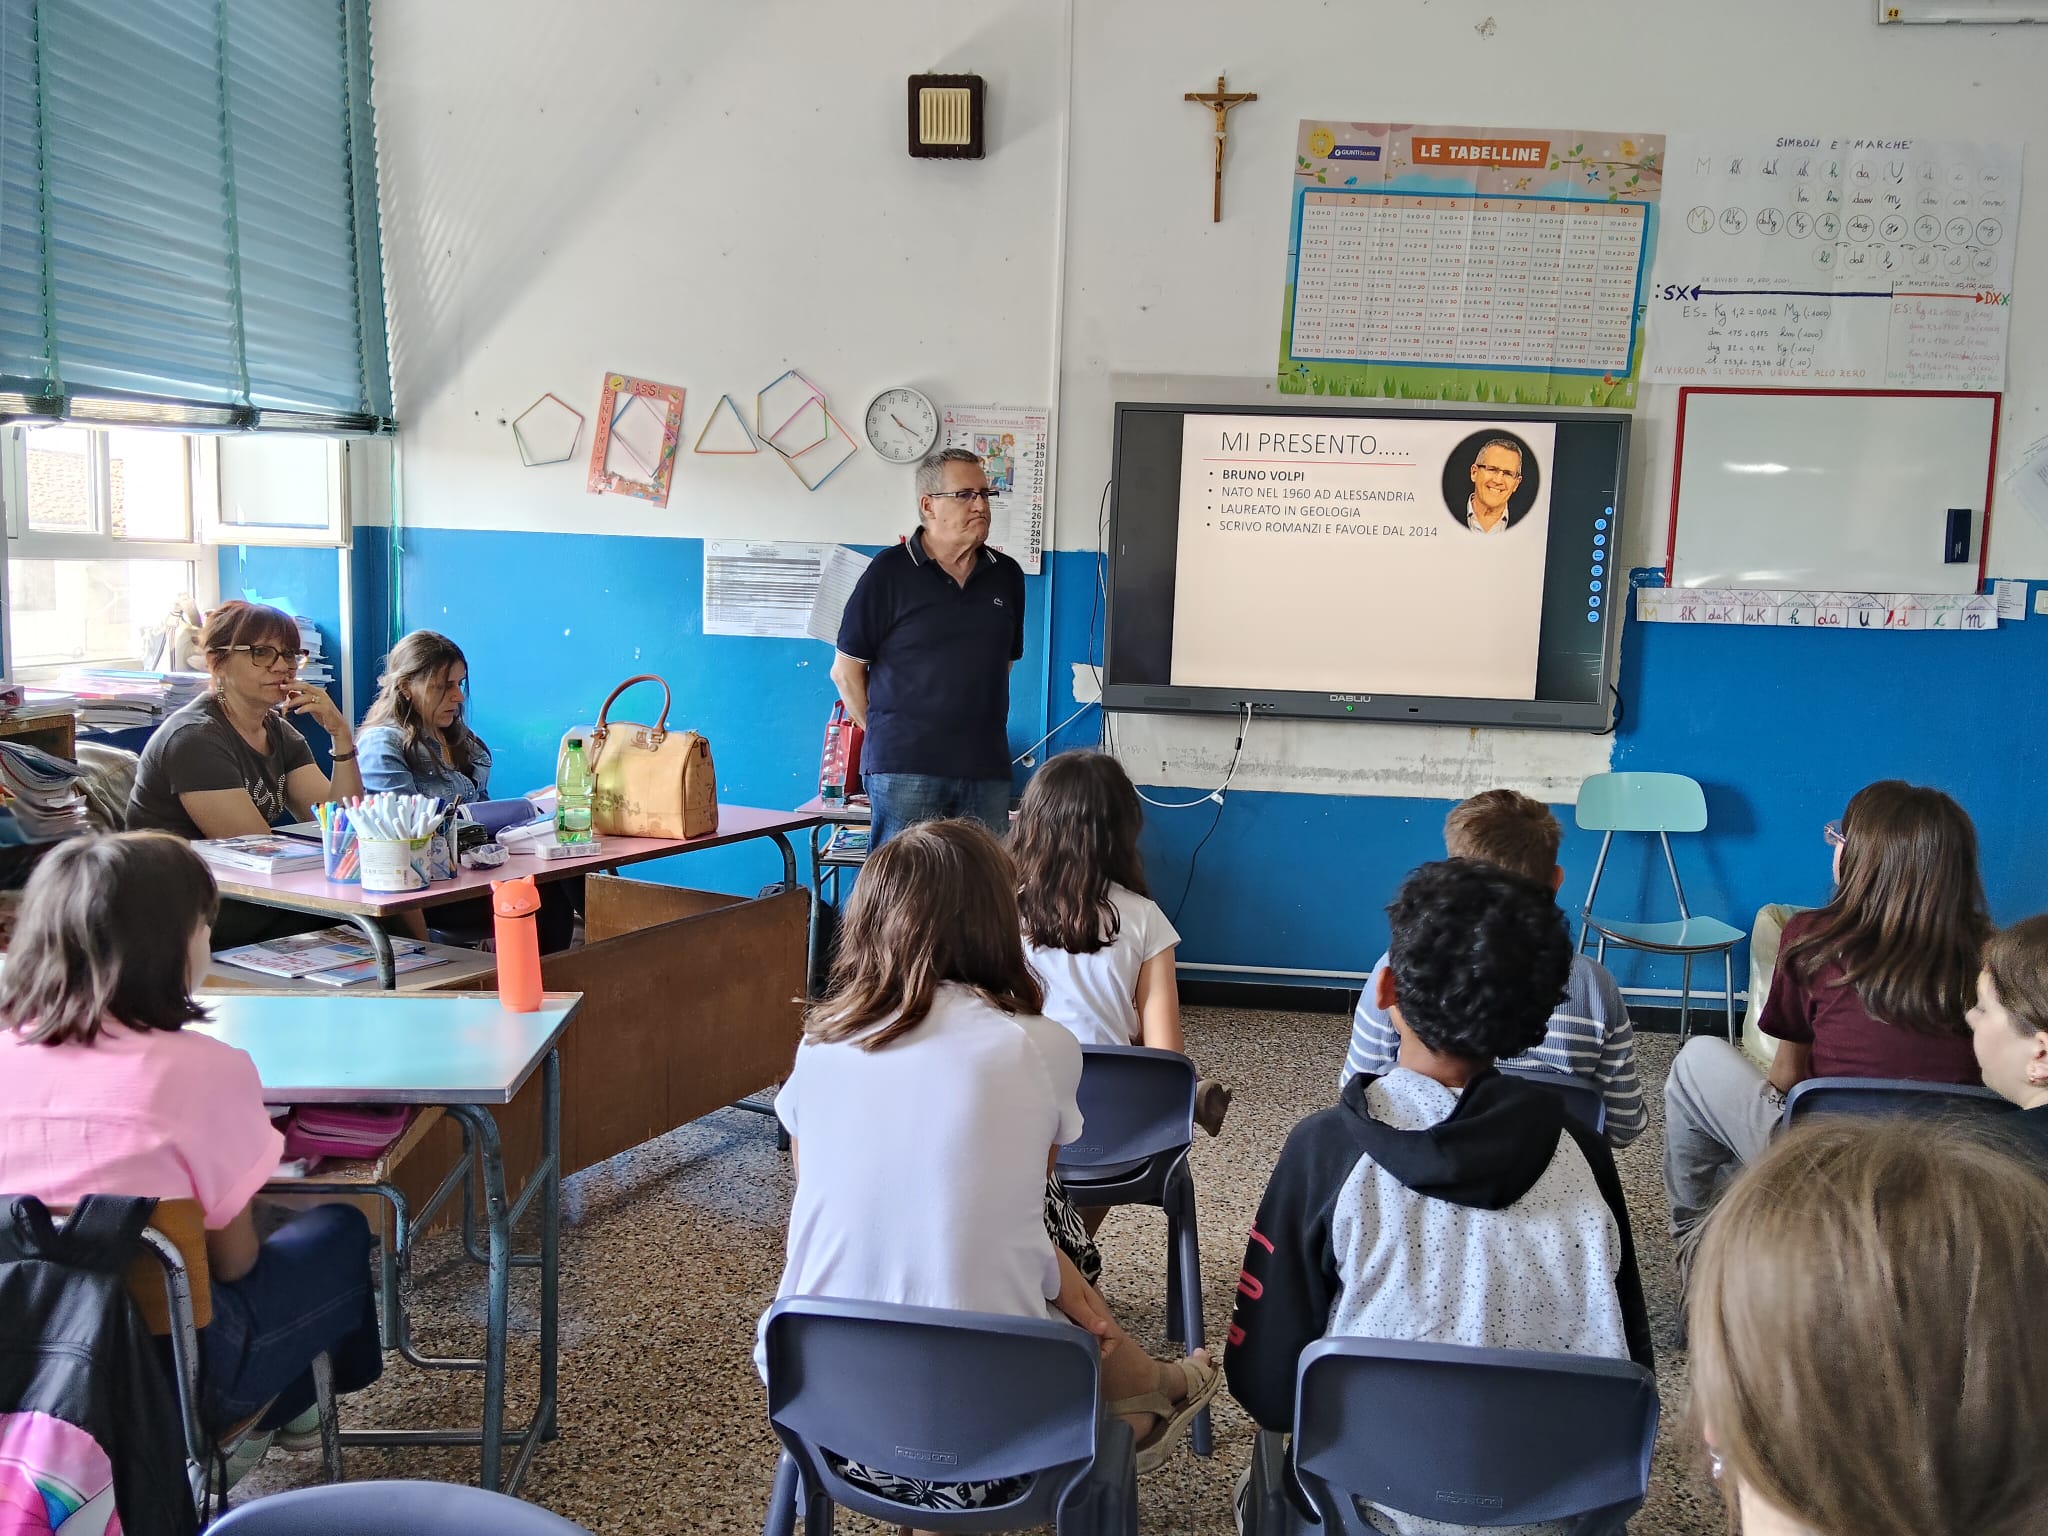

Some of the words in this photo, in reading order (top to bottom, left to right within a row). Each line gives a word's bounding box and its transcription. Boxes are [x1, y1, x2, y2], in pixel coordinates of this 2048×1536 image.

[1776, 137, 1820, 148] SIMBOLI
[1831, 141, 1838, 149] E
[1341, 148, 1360, 156] GIUNTI
[1420, 144, 1441, 158] LE
[1449, 145, 1541, 162] TABELLINE
[1665, 367, 1707, 375] VIRGOLA
[1728, 368, 1763, 376] SPOSTA
[1770, 369, 1808, 377] UGUALE
[1814, 369, 1836, 377] ALLO
[1839, 370, 1866, 378] ZERO
[1221, 431, 1251, 452] MI
[1258, 432, 1411, 457] PRESENTO.....
[1222, 469, 1267, 481] BRUNO
[1269, 470, 1305, 482] VOLPI
[1221, 486, 1254, 498] NATO
[1257, 487, 1280, 499] NEL
[1282, 488, 1311, 500] 1960
[1313, 488, 1331, 500] AD
[1334, 489, 1415, 503] ALESSANDRIA
[1221, 504, 1281, 517] LAUREATO
[1284, 505, 1297, 517] IN
[1300, 505, 1361, 519] GEOLOGIA
[1219, 520, 1262, 533] SCRIVO
[1265, 521, 1323, 535] ROMANZI
[1325, 523, 1332, 535] E
[1335, 523, 1380, 537] FAVOLE
[1383, 524, 1405, 537] DAL
[1409, 525, 1438, 538] 2014
[1644, 607, 1658, 621] M
[1789, 609, 1800, 624] h
[1818, 609, 1840, 626] da
[1859, 611, 1870, 626] U
[1966, 613, 1987, 628] m
[1329, 694, 1371, 703] DABLIU
